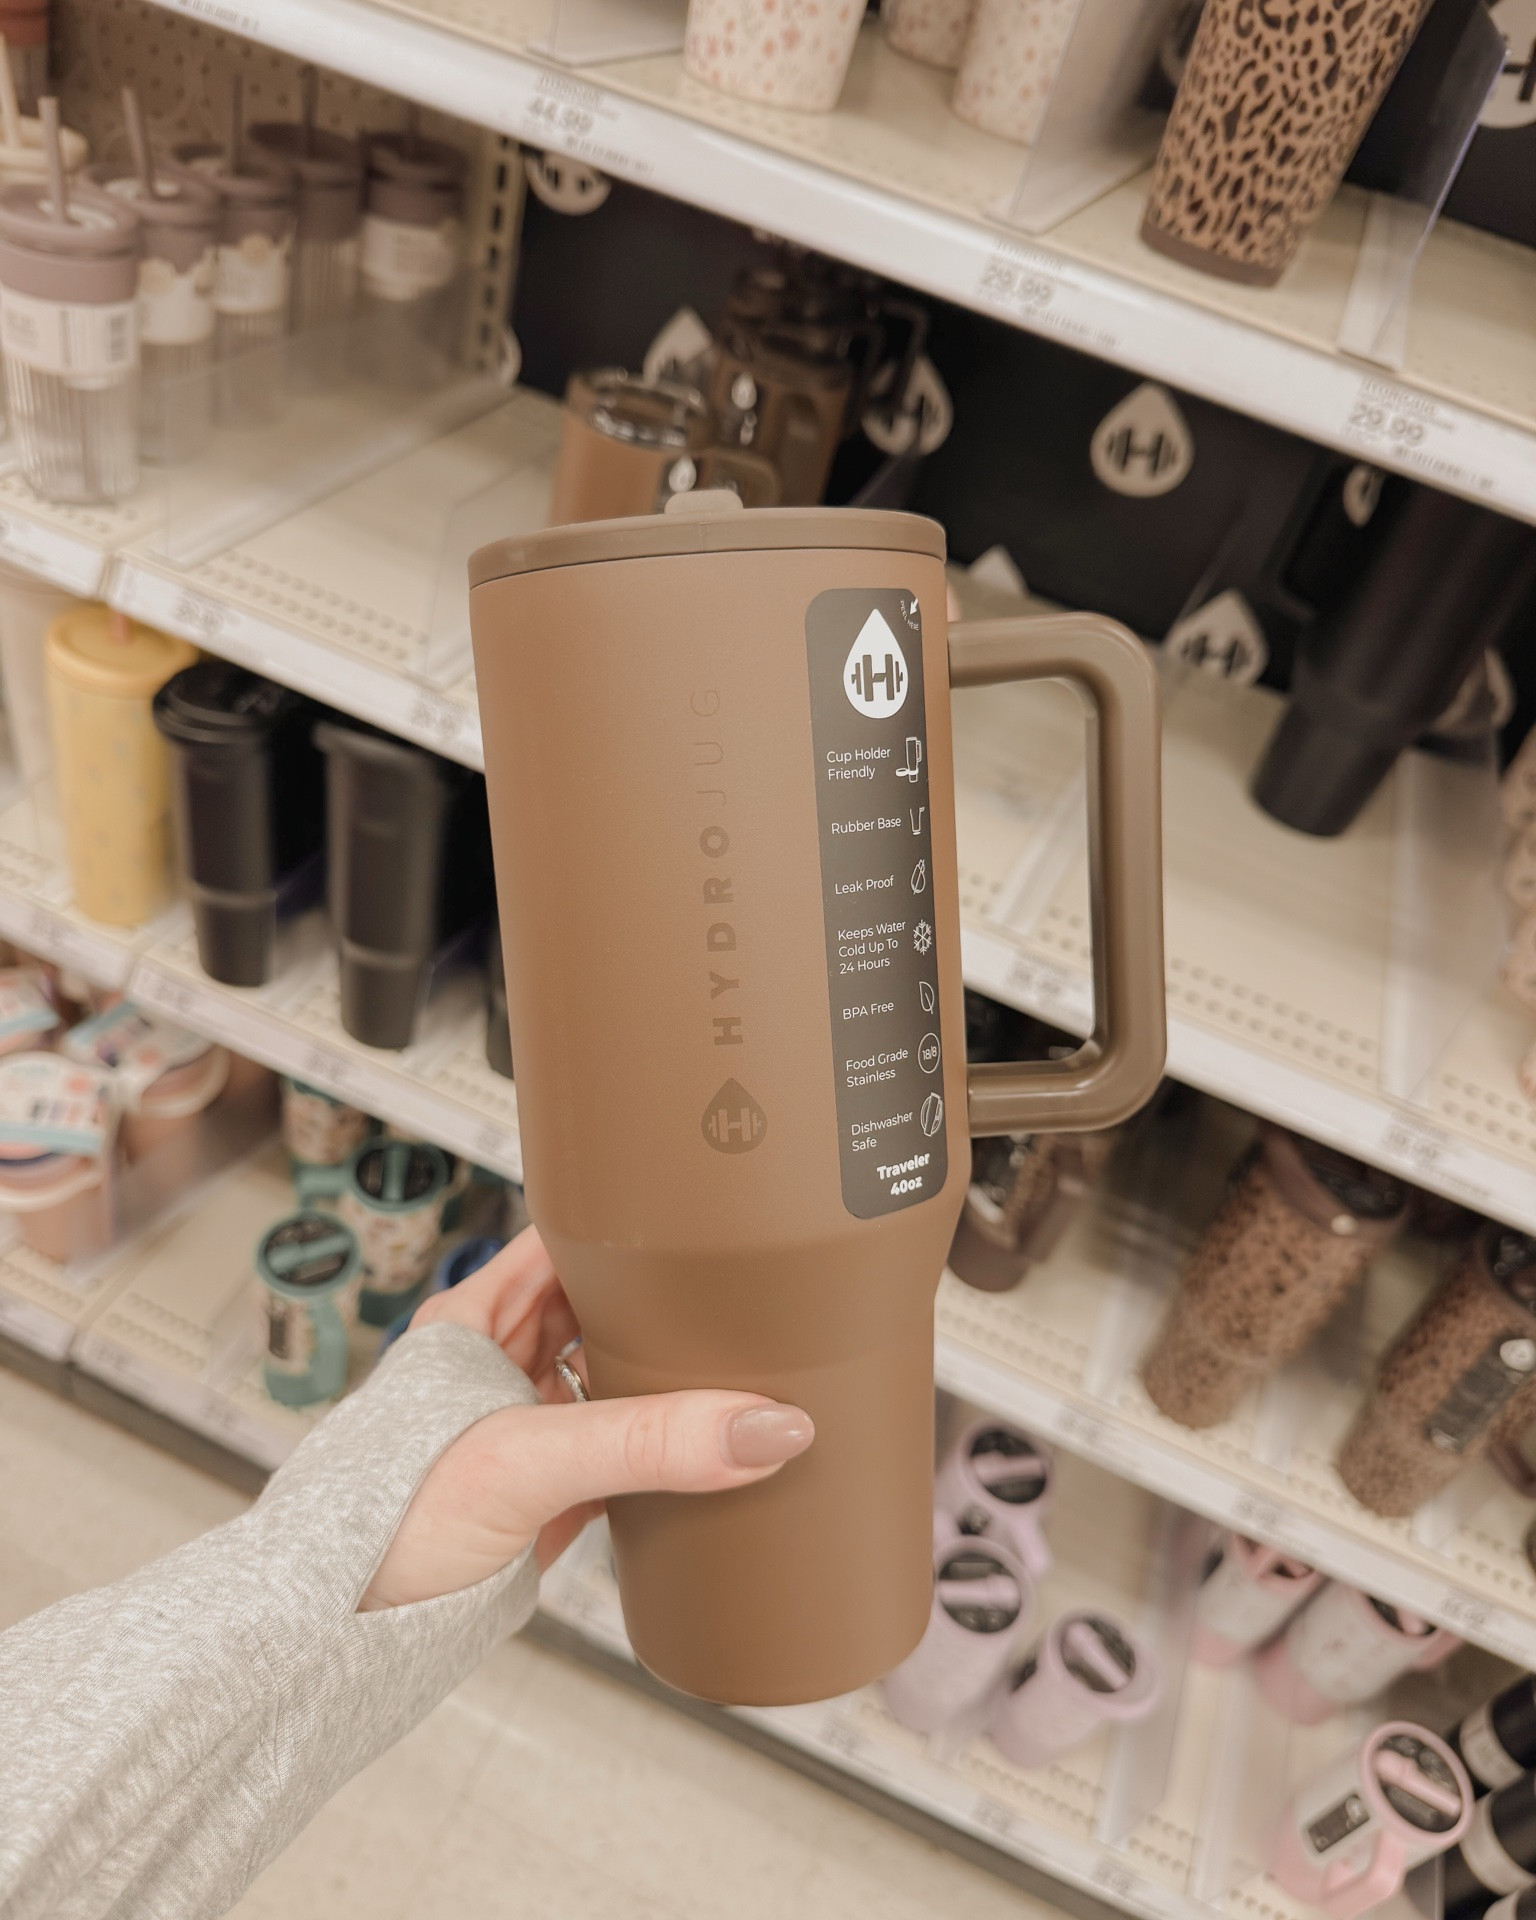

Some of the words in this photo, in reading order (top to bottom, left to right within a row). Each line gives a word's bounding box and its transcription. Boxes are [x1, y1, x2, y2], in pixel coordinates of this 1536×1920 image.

[826, 750, 852, 765] Cup
[855, 747, 891, 761] Holder
[828, 765, 876, 781] Friendly
[831, 819, 875, 835] Rubber
[877, 817, 902, 830] Base
[690, 689, 744, 1046] HYDROJUG
[835, 882, 864, 895] Leak
[866, 875, 895, 891] Proof
[838, 927, 874, 942] Keeps
[876, 921, 906, 935] Water
[838, 943, 866, 958] Cold
[868, 940, 885, 954] Up
[886, 938, 899, 949] To
[840, 962, 855, 975] 24
[857, 957, 891, 972] Hours
[842, 1005, 869, 1020] BPA
[871, 1002, 895, 1015] Free
[846, 1055, 876, 1072] Food
[878, 1048, 909, 1066] Grade
[922, 1045, 938, 1061] 18/8
[846, 1069, 897, 1088] Stainless
[851, 1111, 914, 1136] Dishwasher
[852, 1137, 878, 1152] Safe
[876, 1152, 931, 1181] Traveler
[890, 1176, 923, 1196] 40oz
